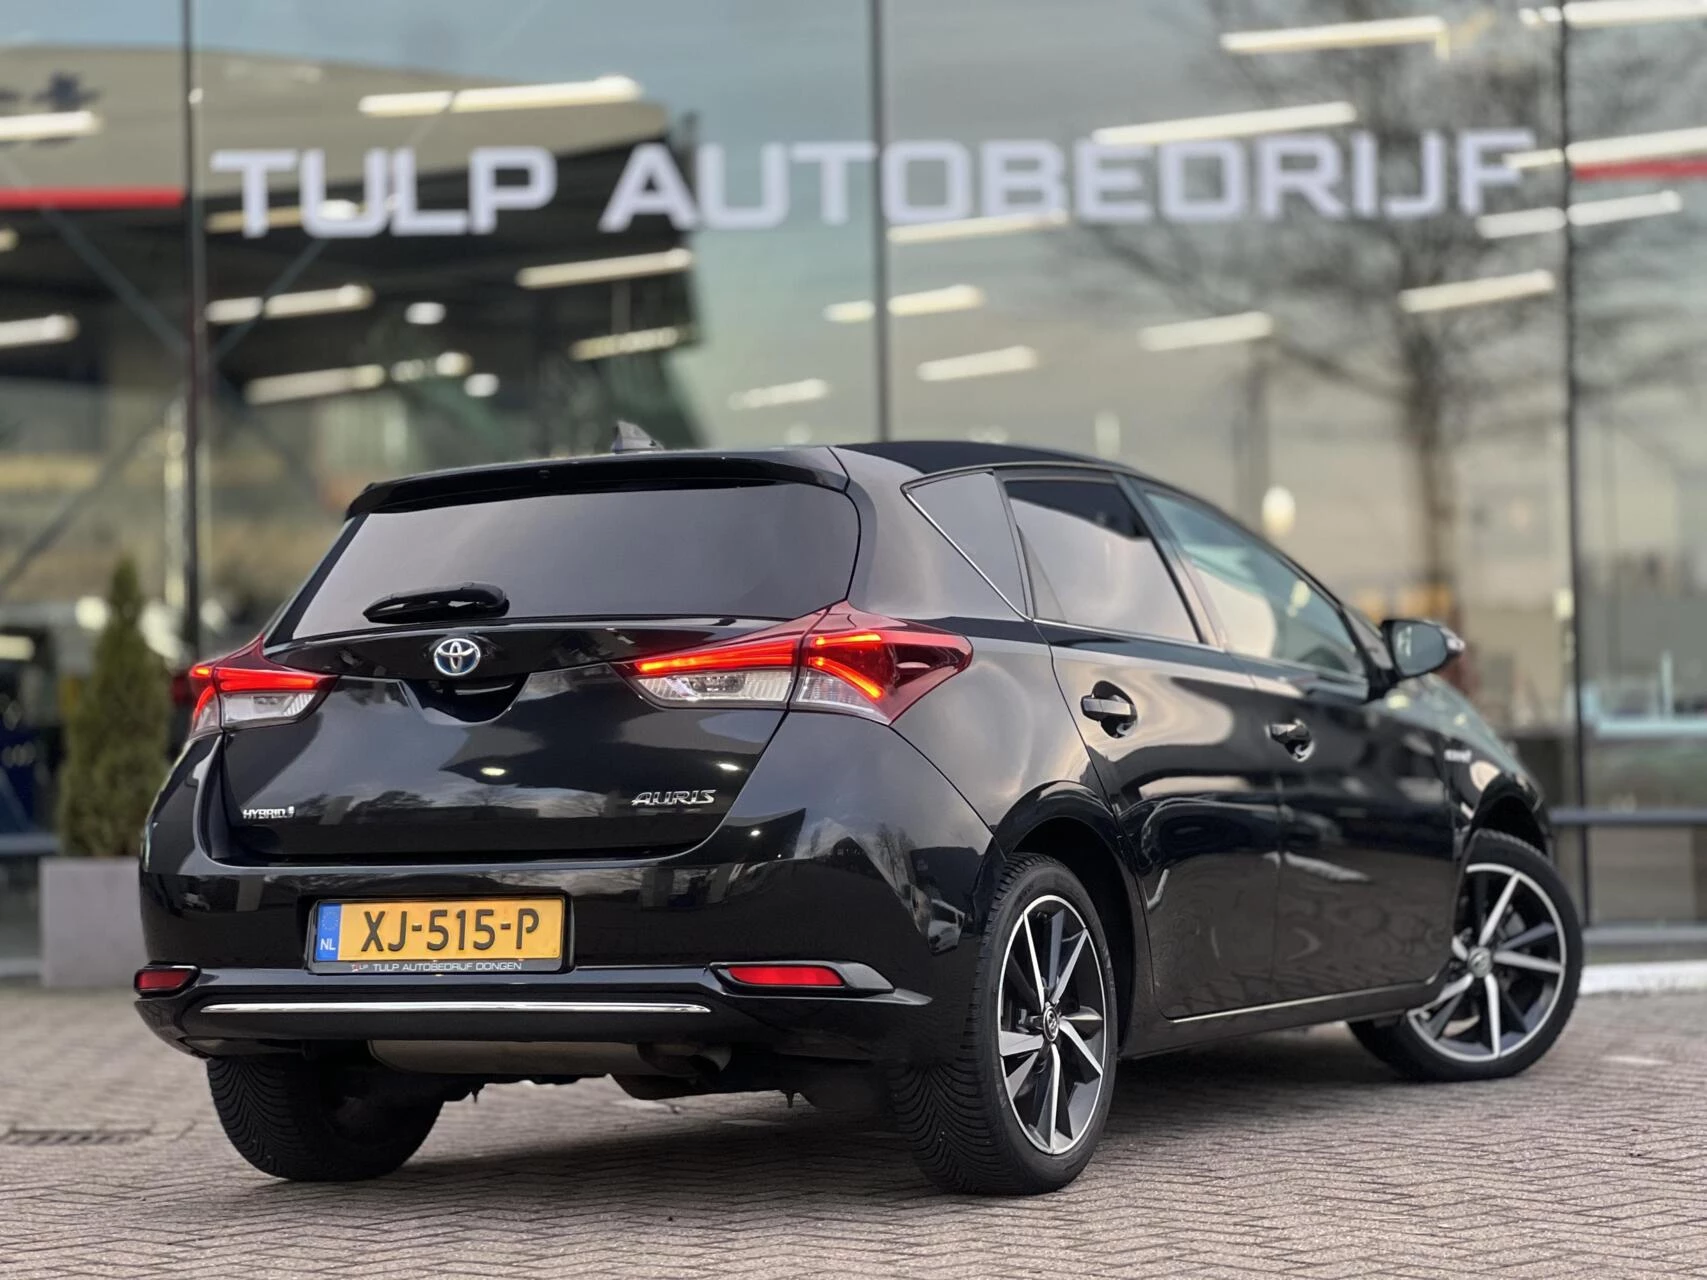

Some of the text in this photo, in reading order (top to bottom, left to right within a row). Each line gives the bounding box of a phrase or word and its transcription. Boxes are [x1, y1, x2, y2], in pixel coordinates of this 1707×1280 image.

[210, 128, 1536, 239] TULP AUTOBEDRIJF
[631, 789, 717, 806] AURIS
[242, 808, 287, 819] HYBRID
[360, 907, 540, 952] XJ-515-P
[320, 937, 337, 951] NL
[372, 962, 400, 972] TULP
[402, 961, 474, 972] AUTOBEDRIJF
[475, 961, 523, 971] DONGEN
